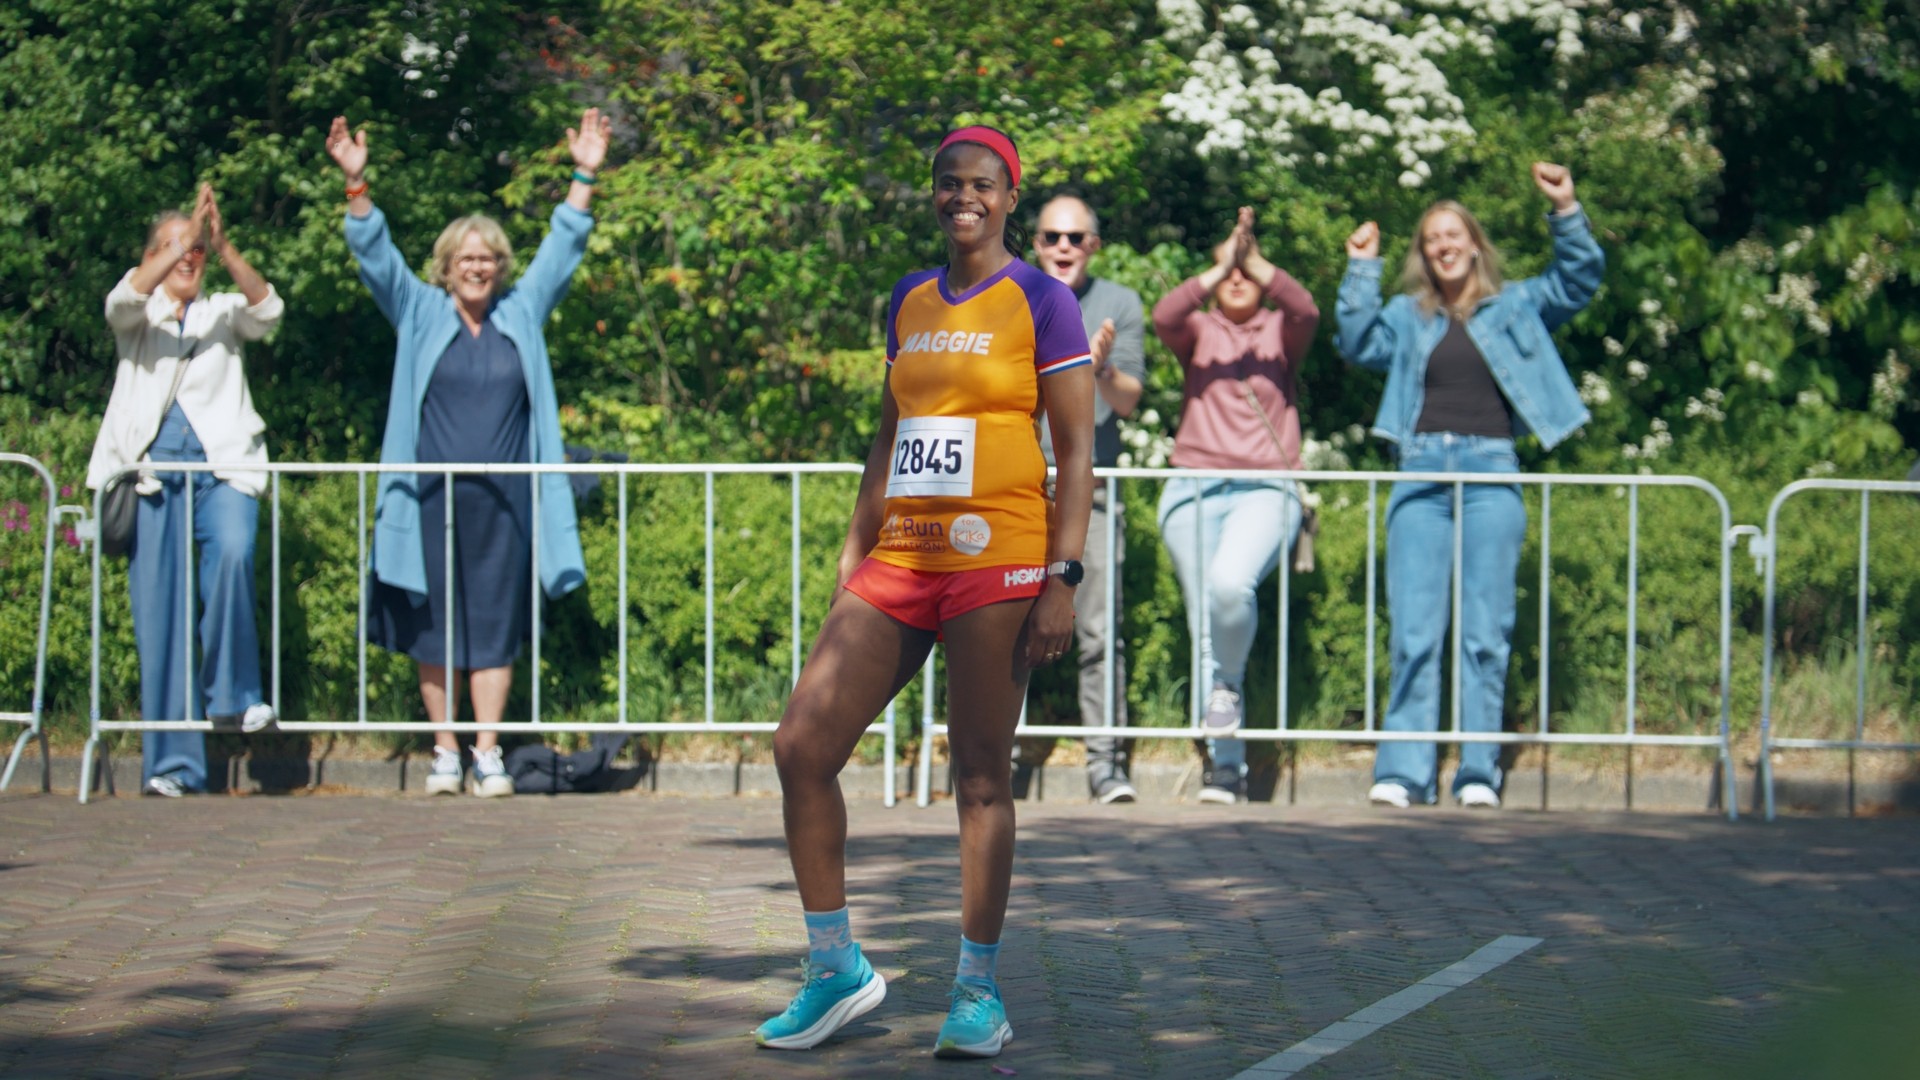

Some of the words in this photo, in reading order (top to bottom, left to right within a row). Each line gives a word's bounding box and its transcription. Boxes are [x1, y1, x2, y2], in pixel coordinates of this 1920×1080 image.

[903, 330, 993, 355] MAGGIE
[894, 438, 963, 476] 12845
[903, 517, 943, 537] Run
[1004, 567, 1046, 587] HOKA
